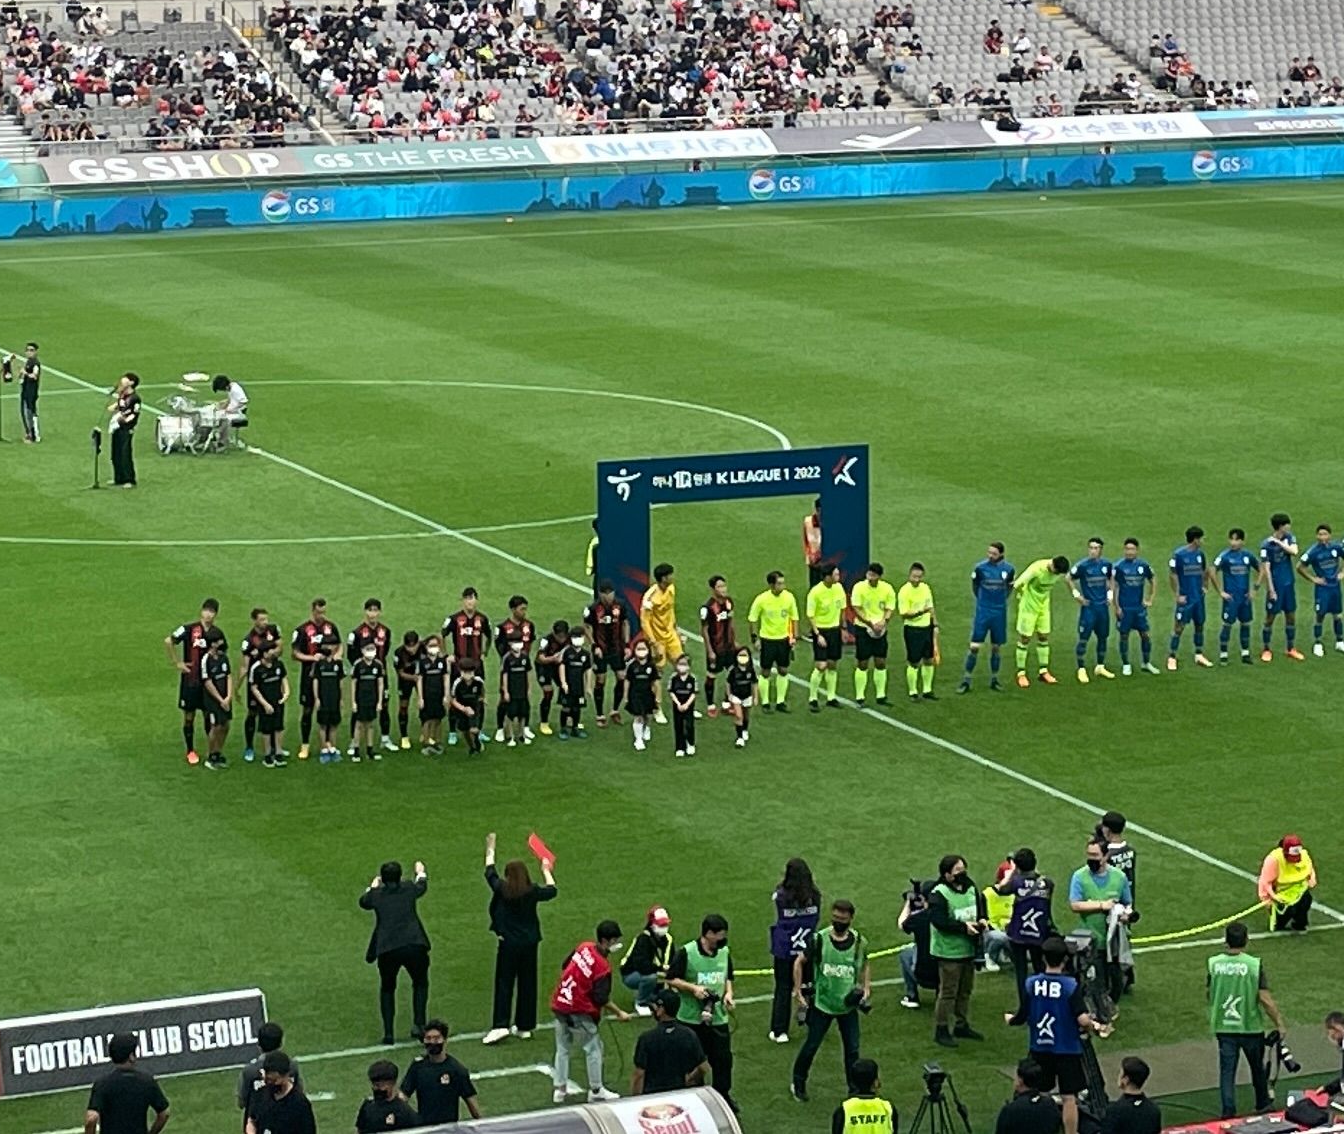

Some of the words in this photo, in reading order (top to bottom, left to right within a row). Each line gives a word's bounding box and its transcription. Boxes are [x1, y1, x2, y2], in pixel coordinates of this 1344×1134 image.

[68, 157, 137, 182] GS
[143, 152, 280, 180] SHOP
[313, 153, 354, 168] GS
[355, 150, 425, 167] THE
[427, 145, 536, 164] FRESH
[716, 471, 728, 484] K
[730, 468, 782, 484] LEAGUE
[794, 467, 821, 480] 2022
[1035, 979, 1062, 998] HB
[134, 1023, 182, 1058] LUB
[187, 1016, 258, 1053] SEOUL
[850, 1114, 886, 1126] STAFF
